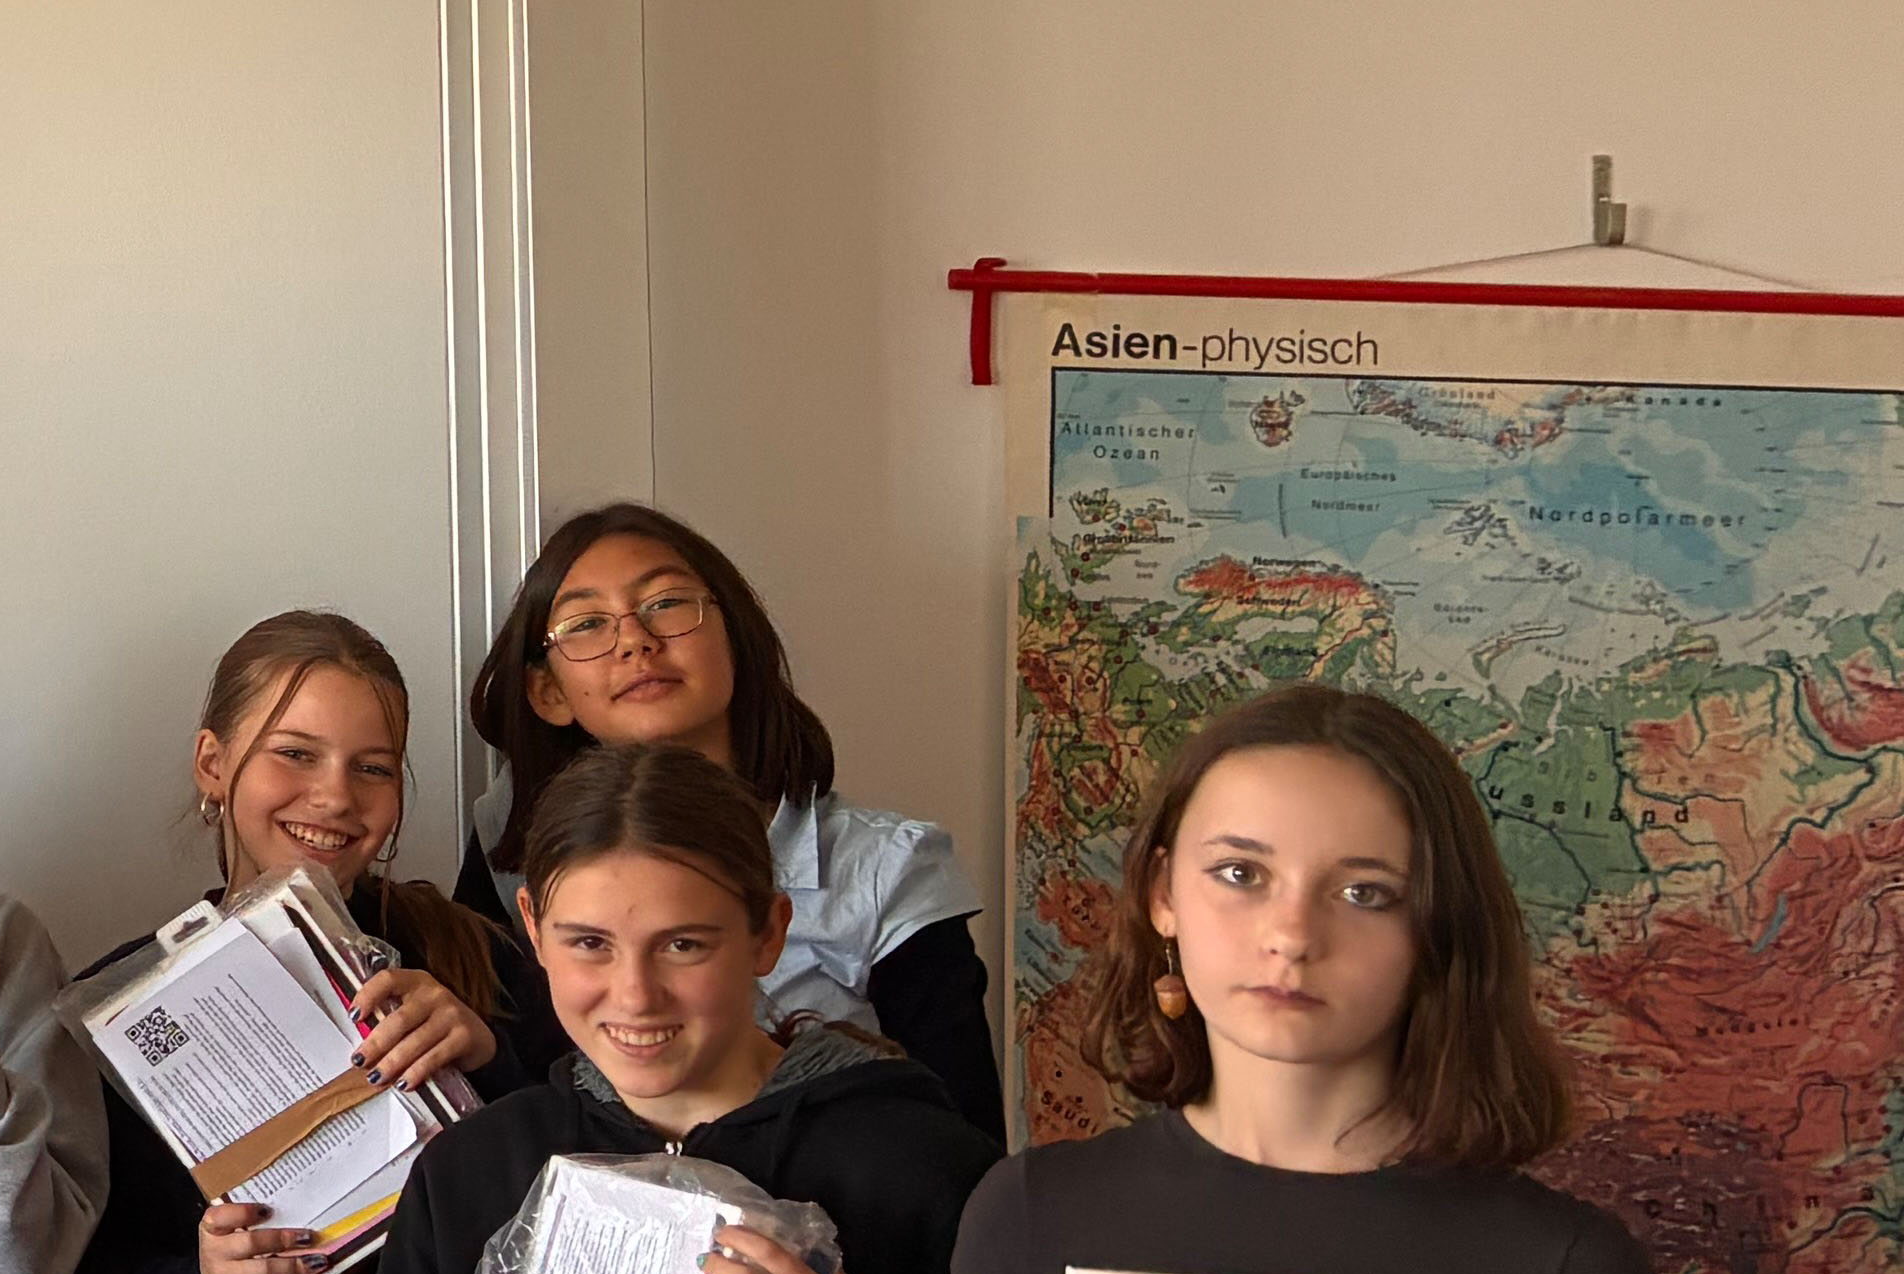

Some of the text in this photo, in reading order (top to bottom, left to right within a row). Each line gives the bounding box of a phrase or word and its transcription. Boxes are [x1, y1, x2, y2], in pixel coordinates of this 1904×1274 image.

[1051, 322, 1379, 369] Asien-physisch
[1060, 421, 1195, 439] Atlantischer
[1093, 446, 1160, 462] Ozean
[1529, 505, 1746, 527] Nordpolarmeer
[1489, 785, 1689, 824] ussland
